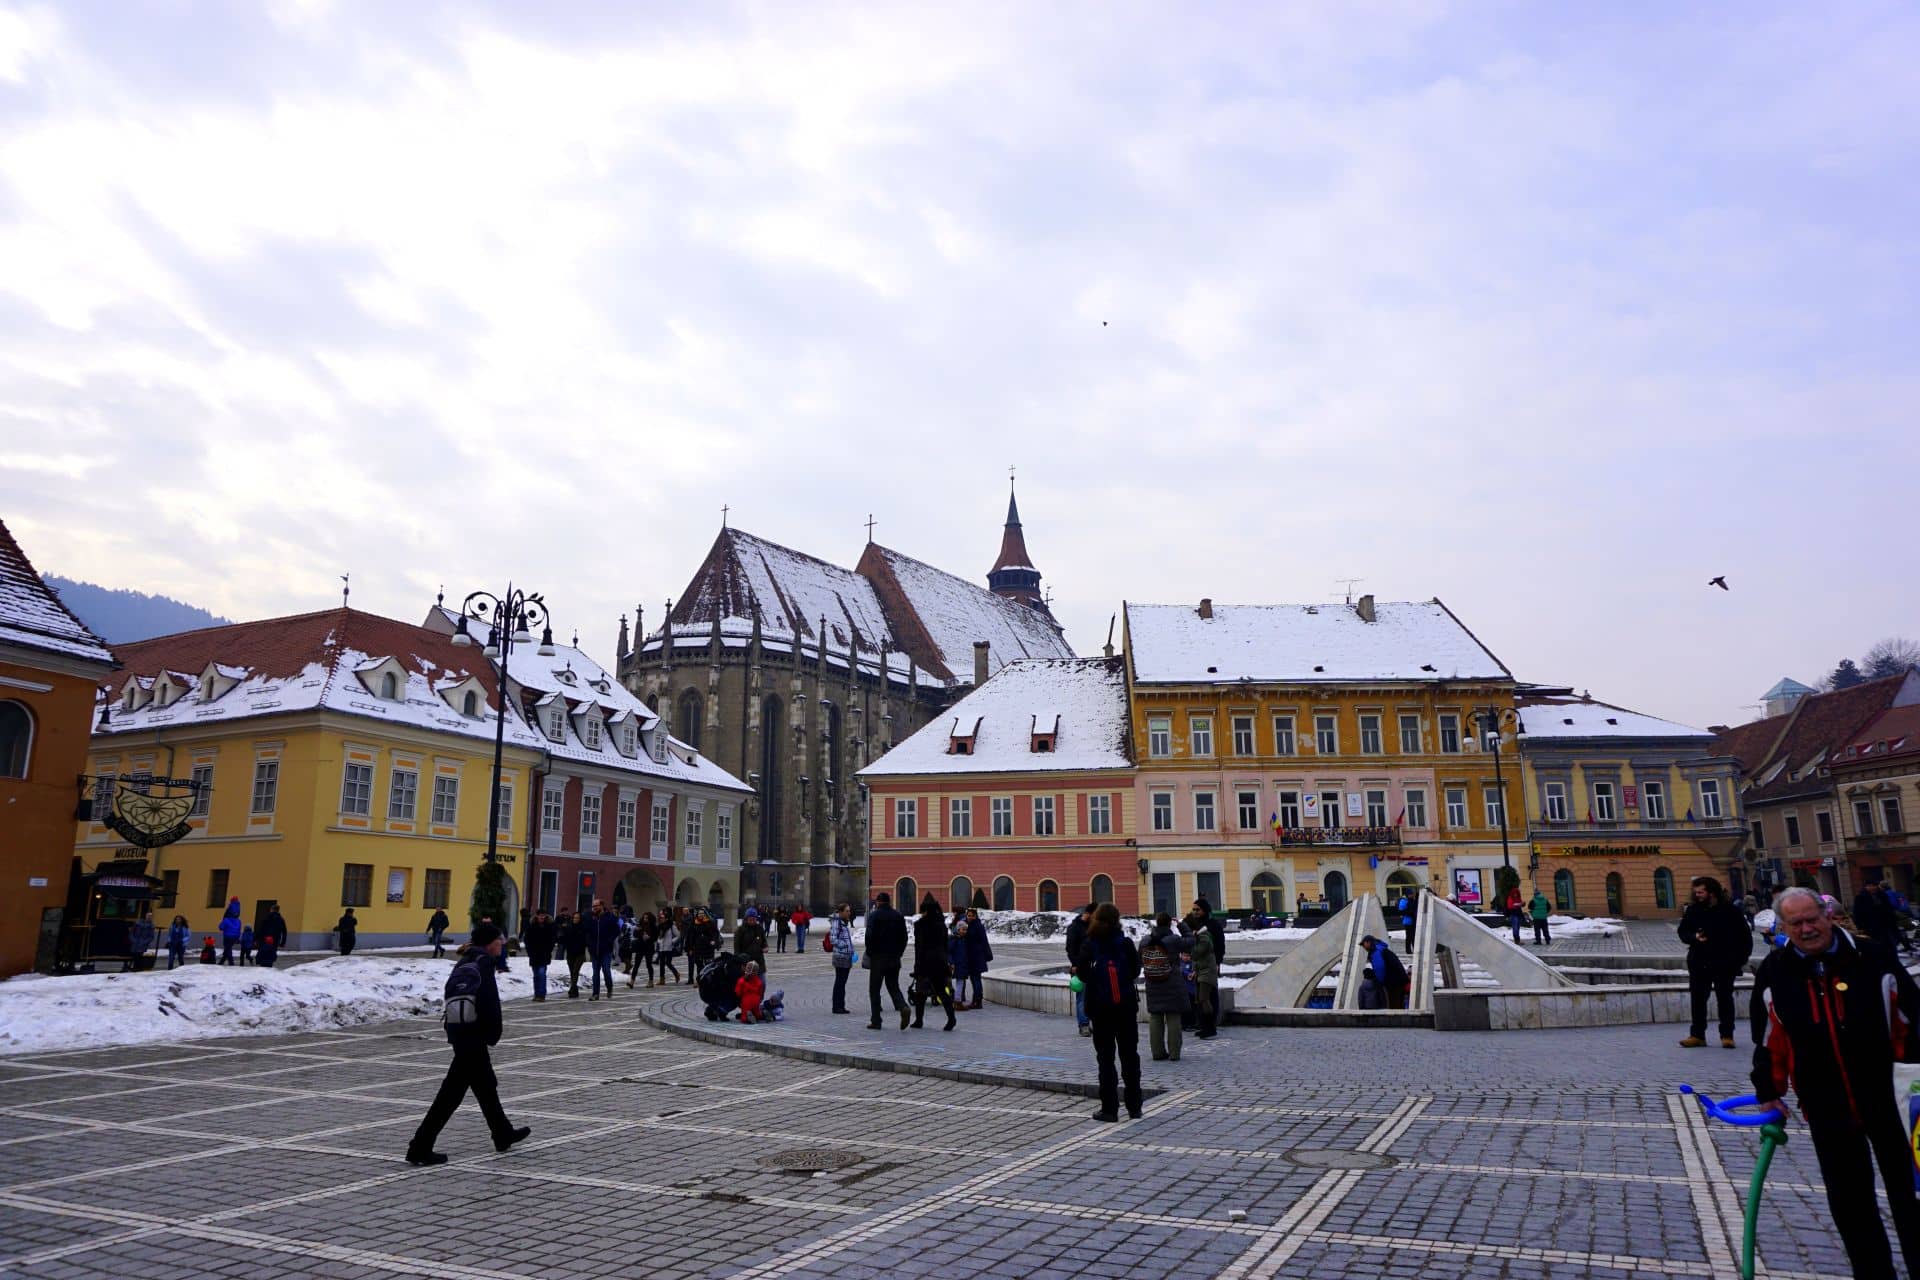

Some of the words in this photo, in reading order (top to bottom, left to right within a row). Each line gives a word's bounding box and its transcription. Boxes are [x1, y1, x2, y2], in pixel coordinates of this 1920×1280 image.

[115, 847, 148, 858] MUSEUM
[1574, 845, 1628, 856] Raiffeisen
[1629, 845, 1660, 855] BANK
